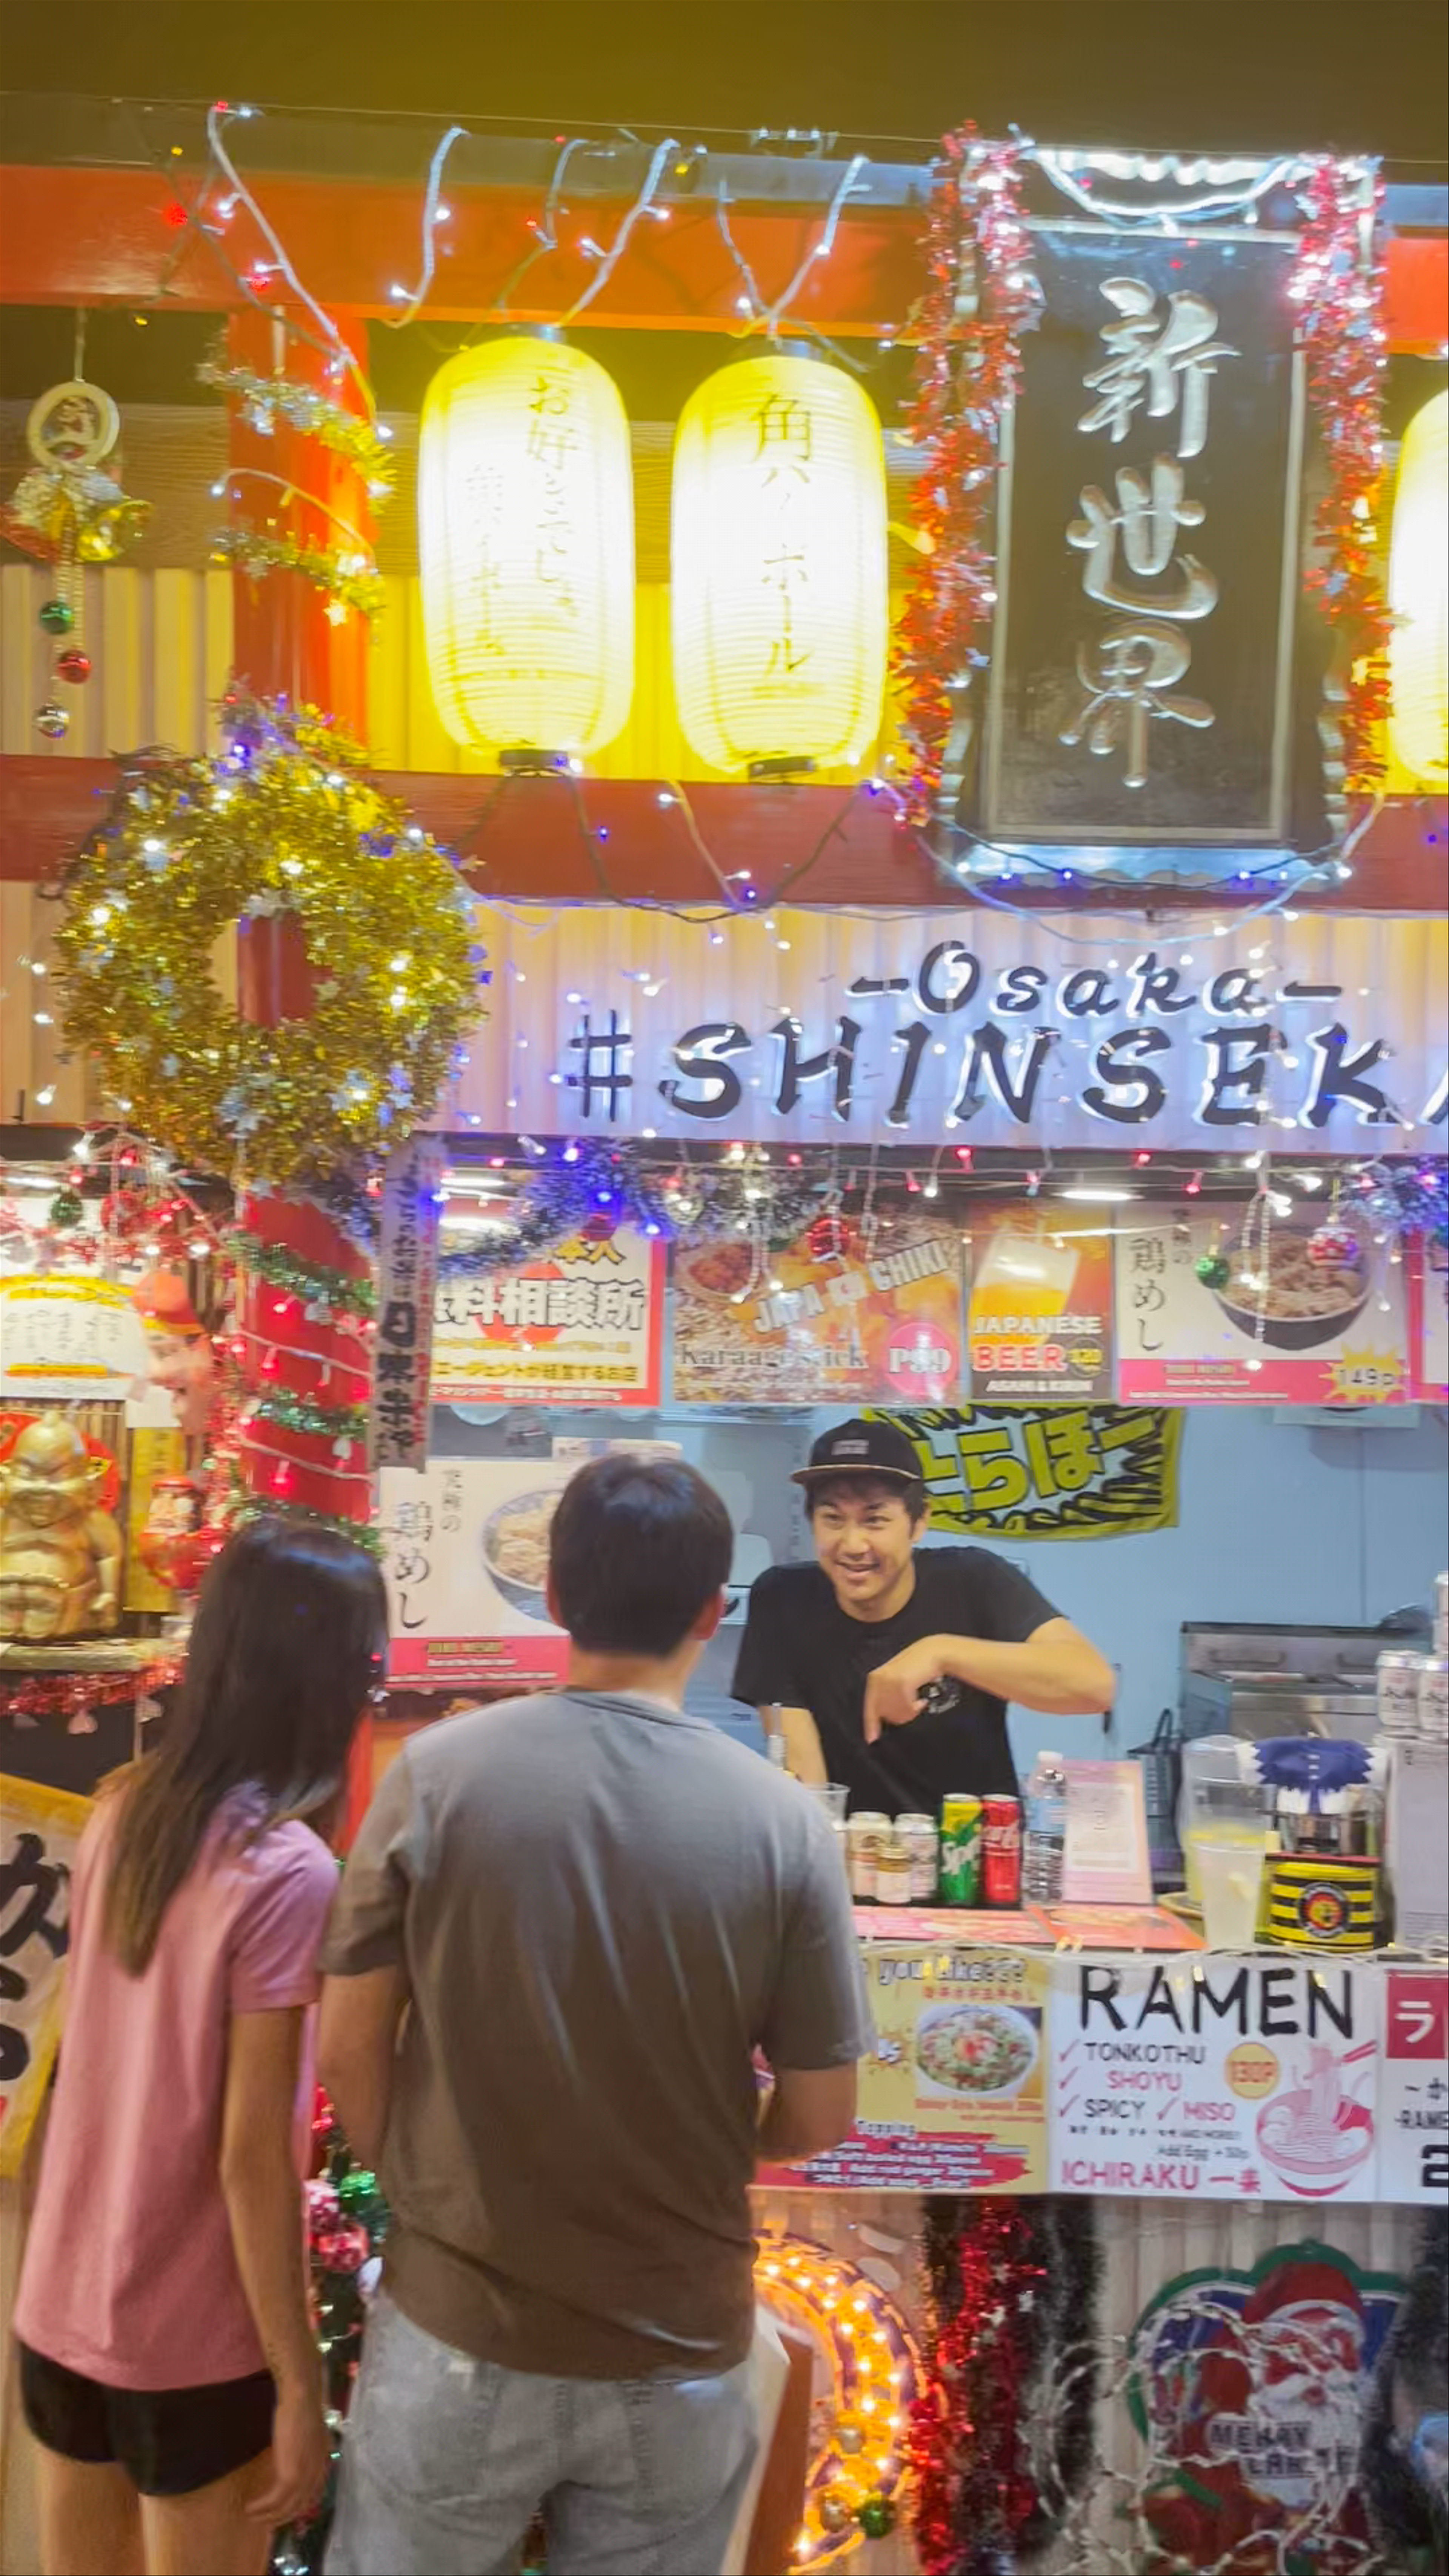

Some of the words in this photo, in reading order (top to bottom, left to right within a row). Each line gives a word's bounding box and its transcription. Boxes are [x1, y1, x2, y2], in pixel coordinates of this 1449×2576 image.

[974, 1315, 1103, 1334] JAPANESE
[972, 1343, 1066, 1372] BEER
[1080, 1964, 1352, 2039] RAMEN
[1084, 2042, 1206, 2064] TONKOTHU
[1108, 2070, 1182, 2092] SHOYU
[1084, 2098, 1146, 2119] SPICY
[1183, 2102, 1236, 2121] MISO
[1062, 2160, 1199, 2190] ICHIRAKU
